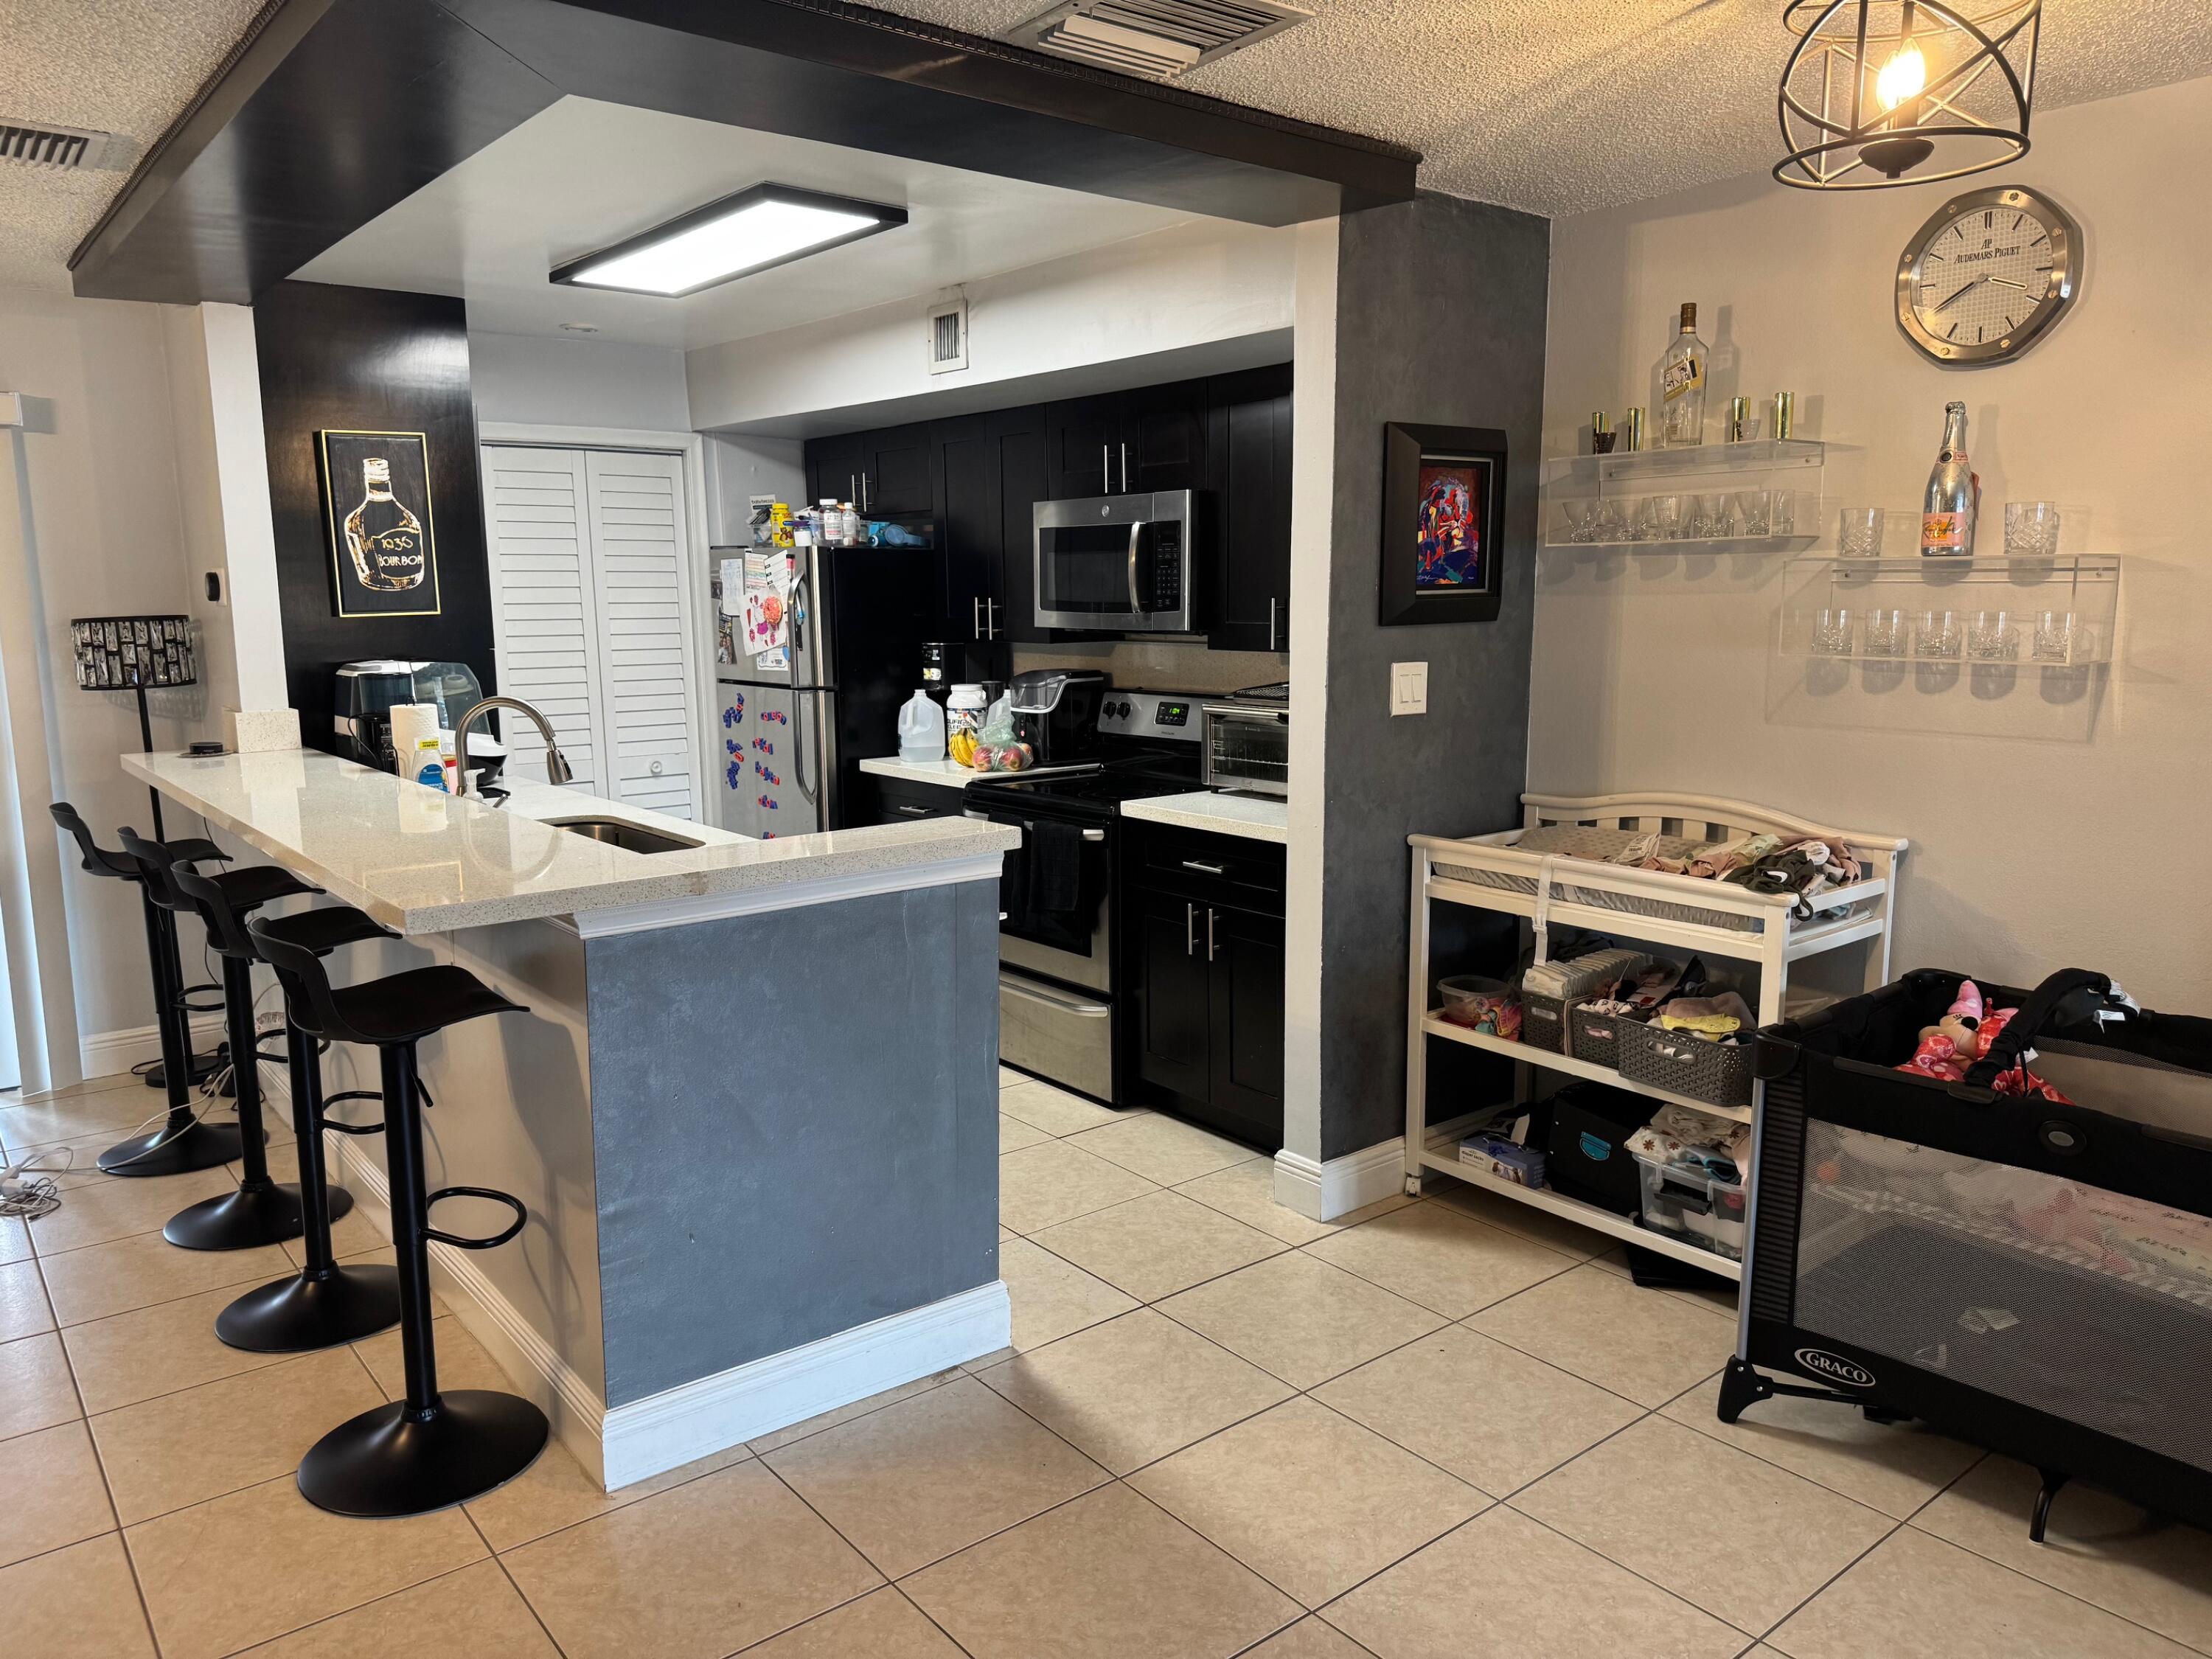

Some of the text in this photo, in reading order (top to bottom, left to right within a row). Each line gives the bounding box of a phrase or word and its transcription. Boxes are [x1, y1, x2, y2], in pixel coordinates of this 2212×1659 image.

[1981, 238, 1992, 250] AP
[1953, 246, 2020, 264] AUDEMARS PIGUET
[1806, 1352, 1868, 1382] GRACO
